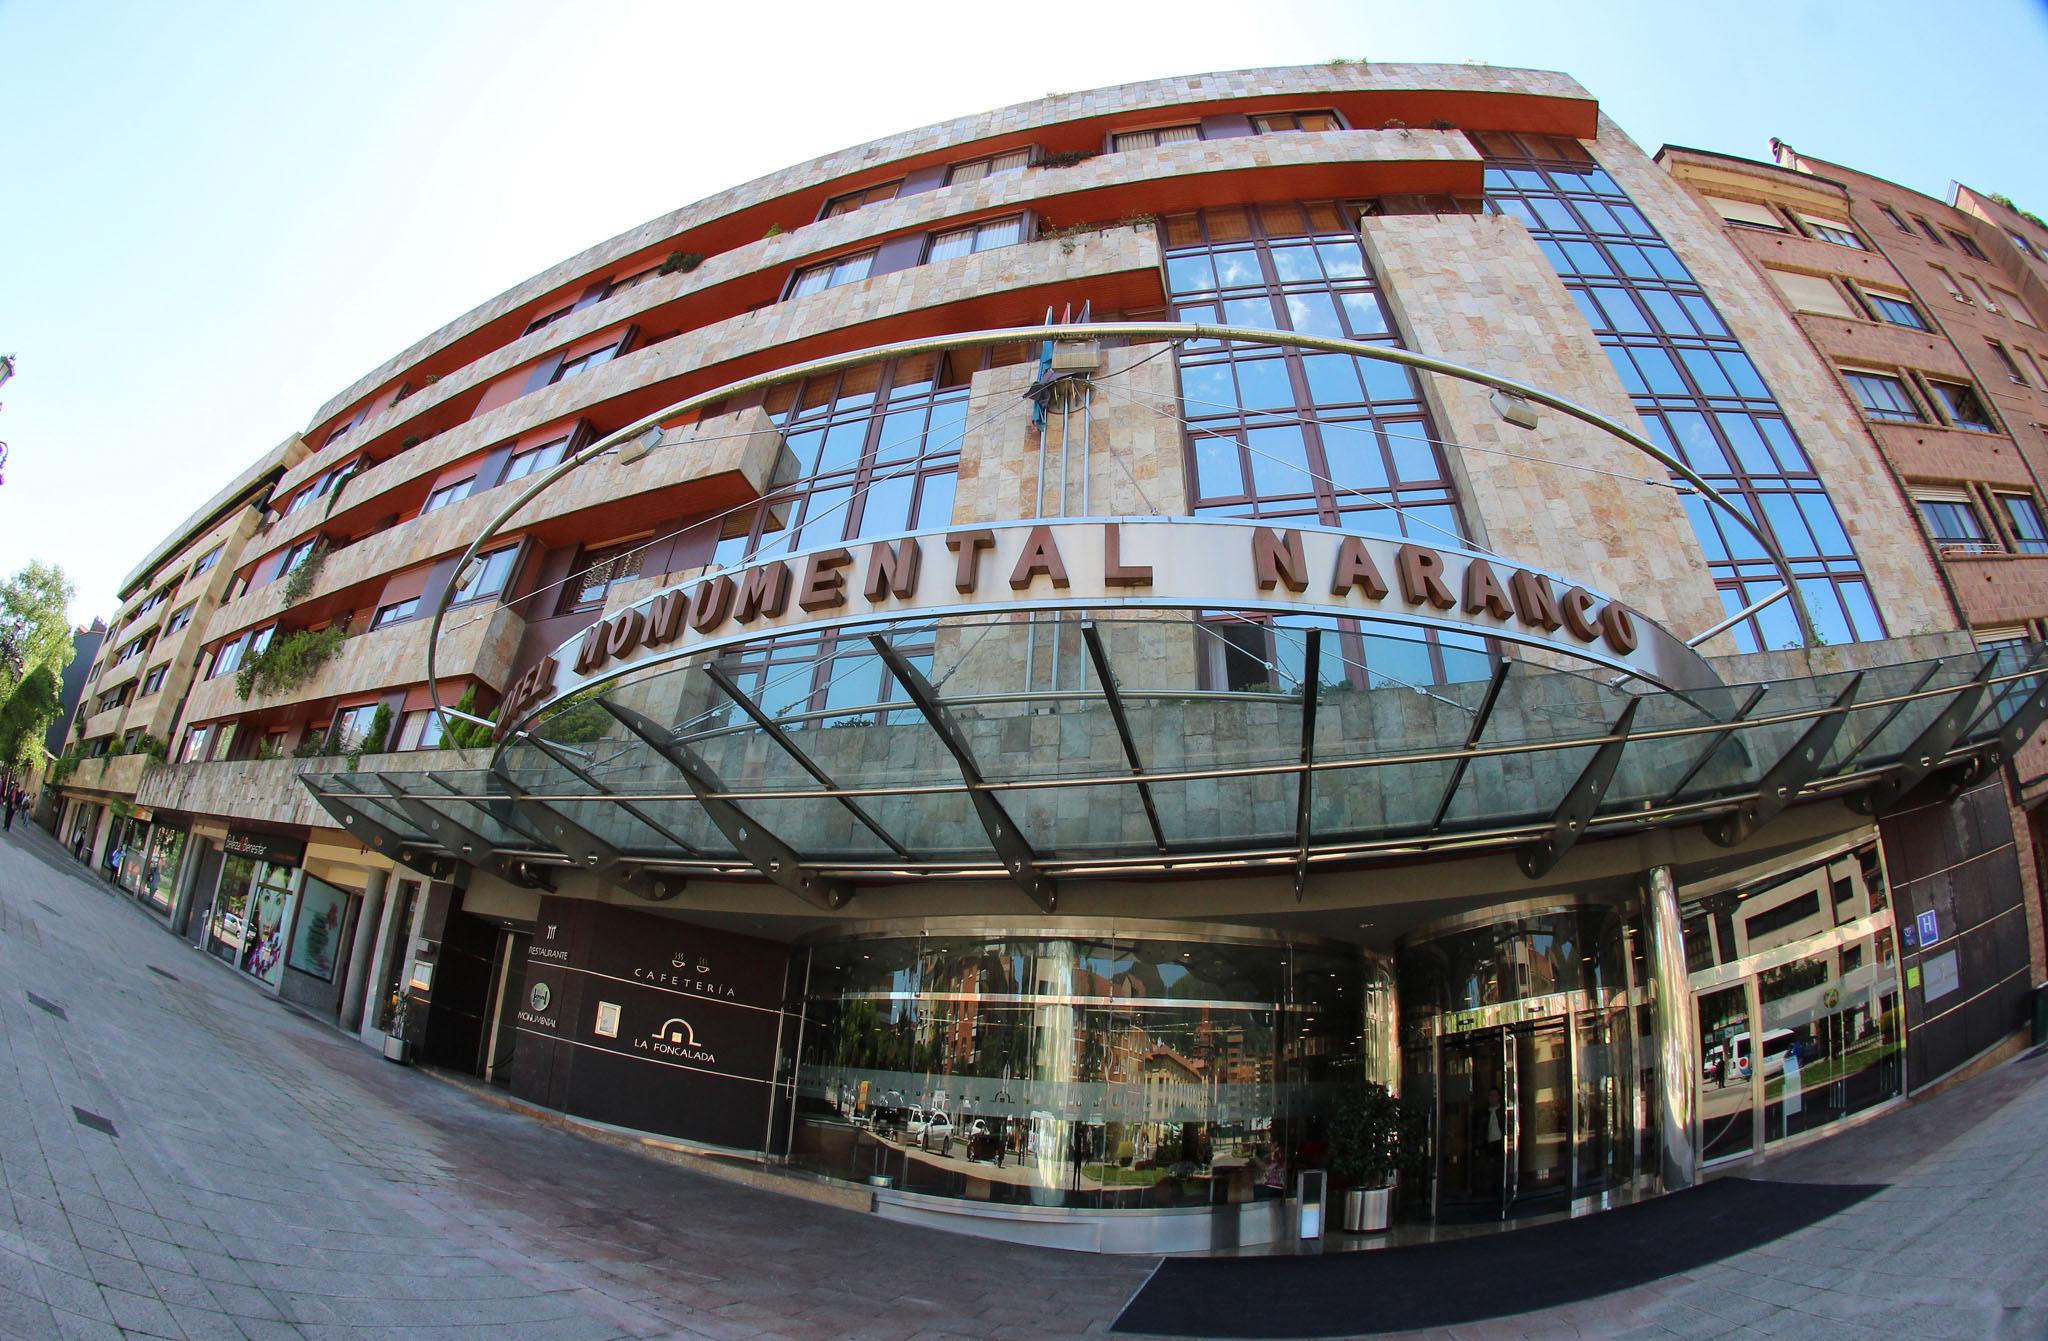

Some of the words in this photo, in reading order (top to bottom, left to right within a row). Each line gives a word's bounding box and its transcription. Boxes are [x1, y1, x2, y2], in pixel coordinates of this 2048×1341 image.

[572, 523, 1153, 676] MONUMENTAL
[1252, 526, 1638, 656] NARANCO
[1922, 915, 1933, 932] H
[528, 945, 568, 960] RESTAURANTE
[634, 968, 735, 997] CAFETERÍA
[517, 1011, 556, 1028] MONUMENTAL
[634, 1039, 648, 1049] LA
[653, 1043, 715, 1063] FONCALADA
